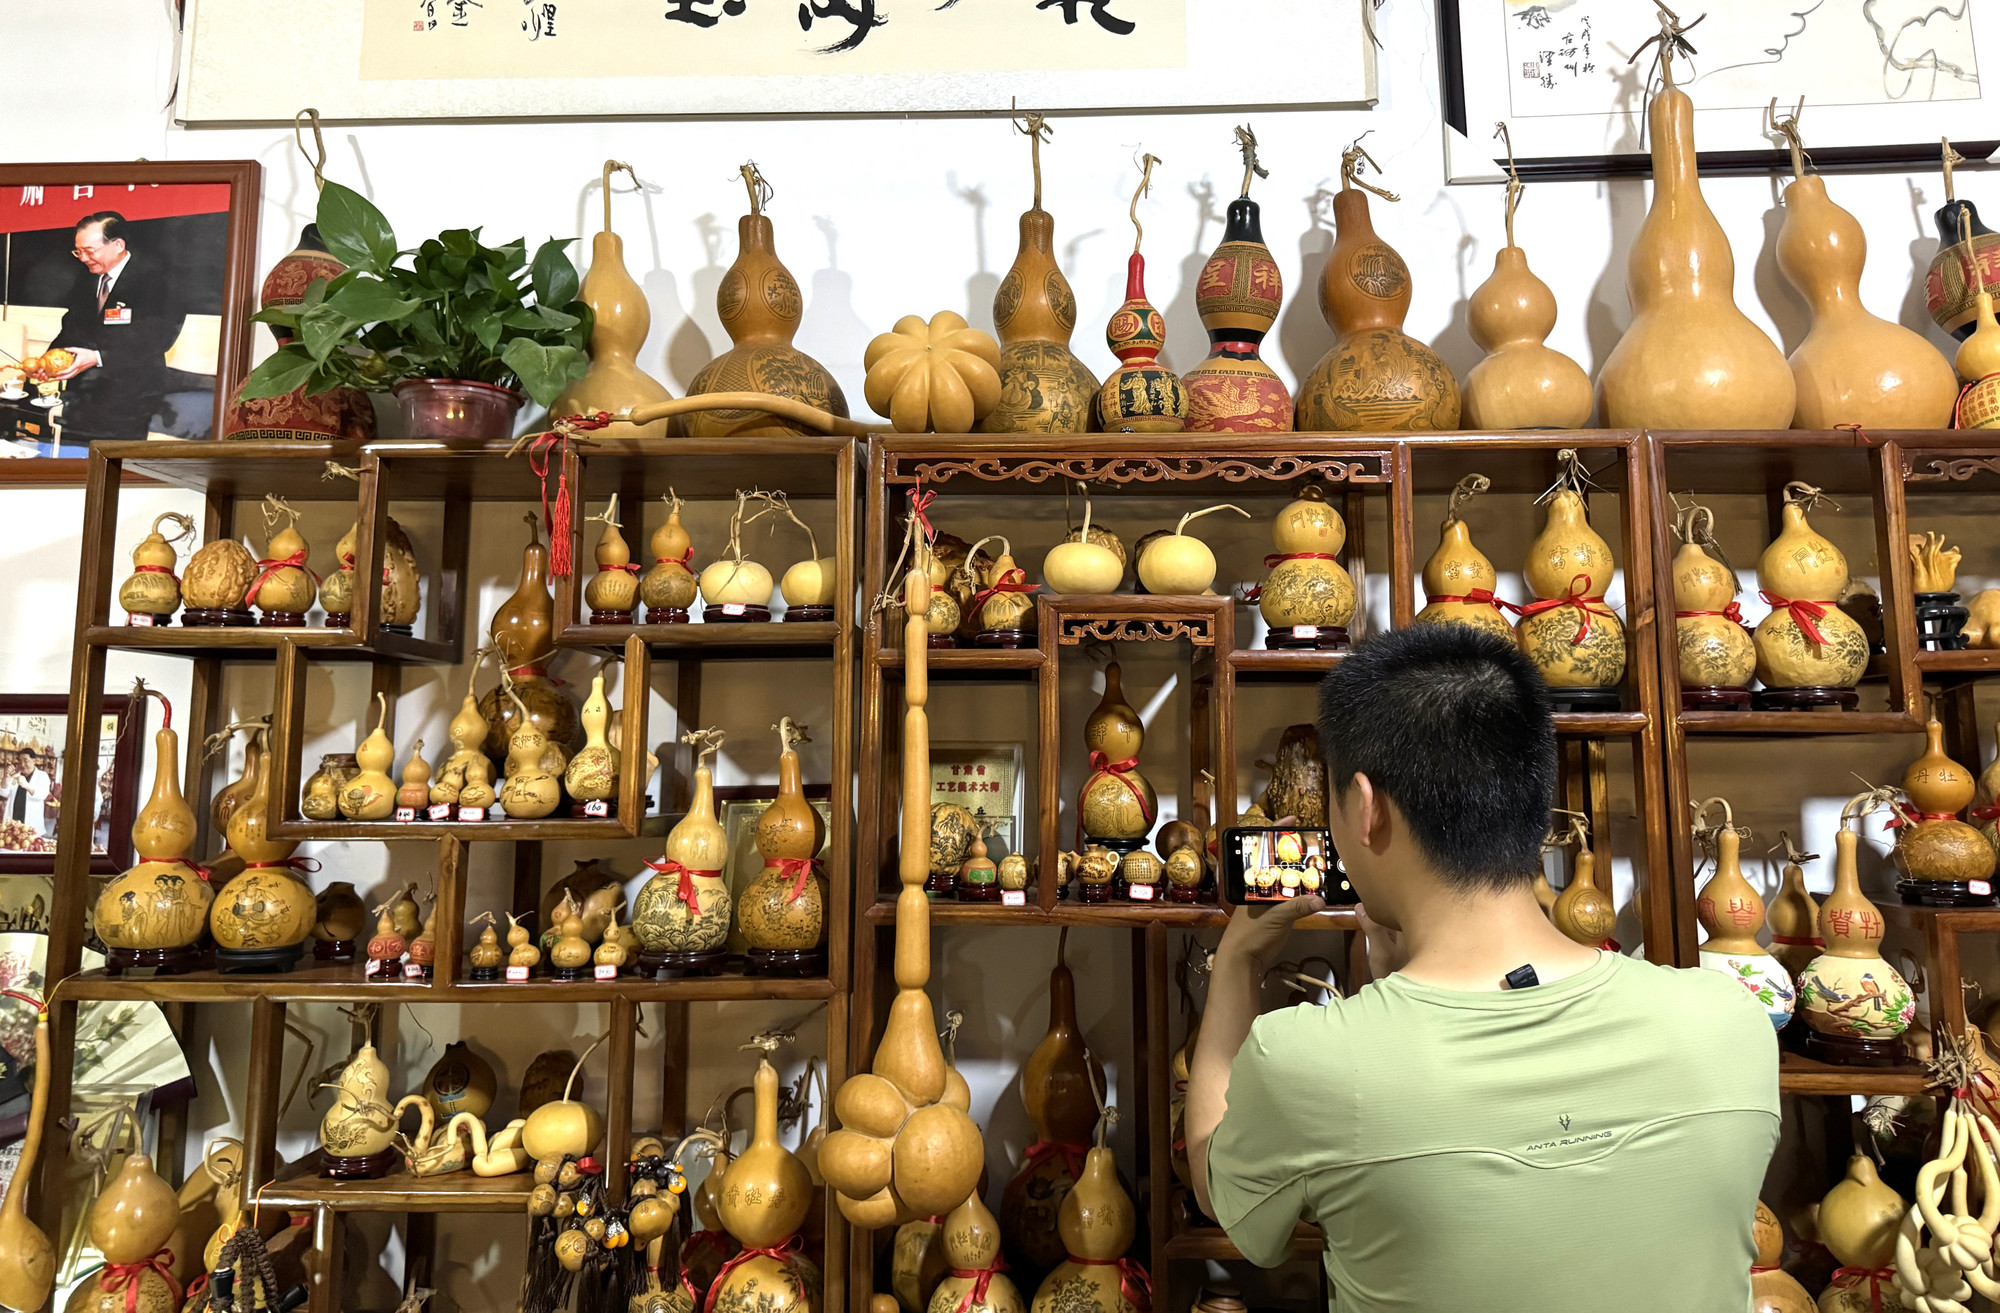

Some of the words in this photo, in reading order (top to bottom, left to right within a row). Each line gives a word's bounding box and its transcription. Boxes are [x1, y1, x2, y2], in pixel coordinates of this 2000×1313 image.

[950, 764, 986, 776] 甘肃省
[936, 781, 1000, 793] 工艺美术大师
[1526, 1142, 1557, 1152] ANTA
[1560, 1131, 1612, 1146] RUNNING
